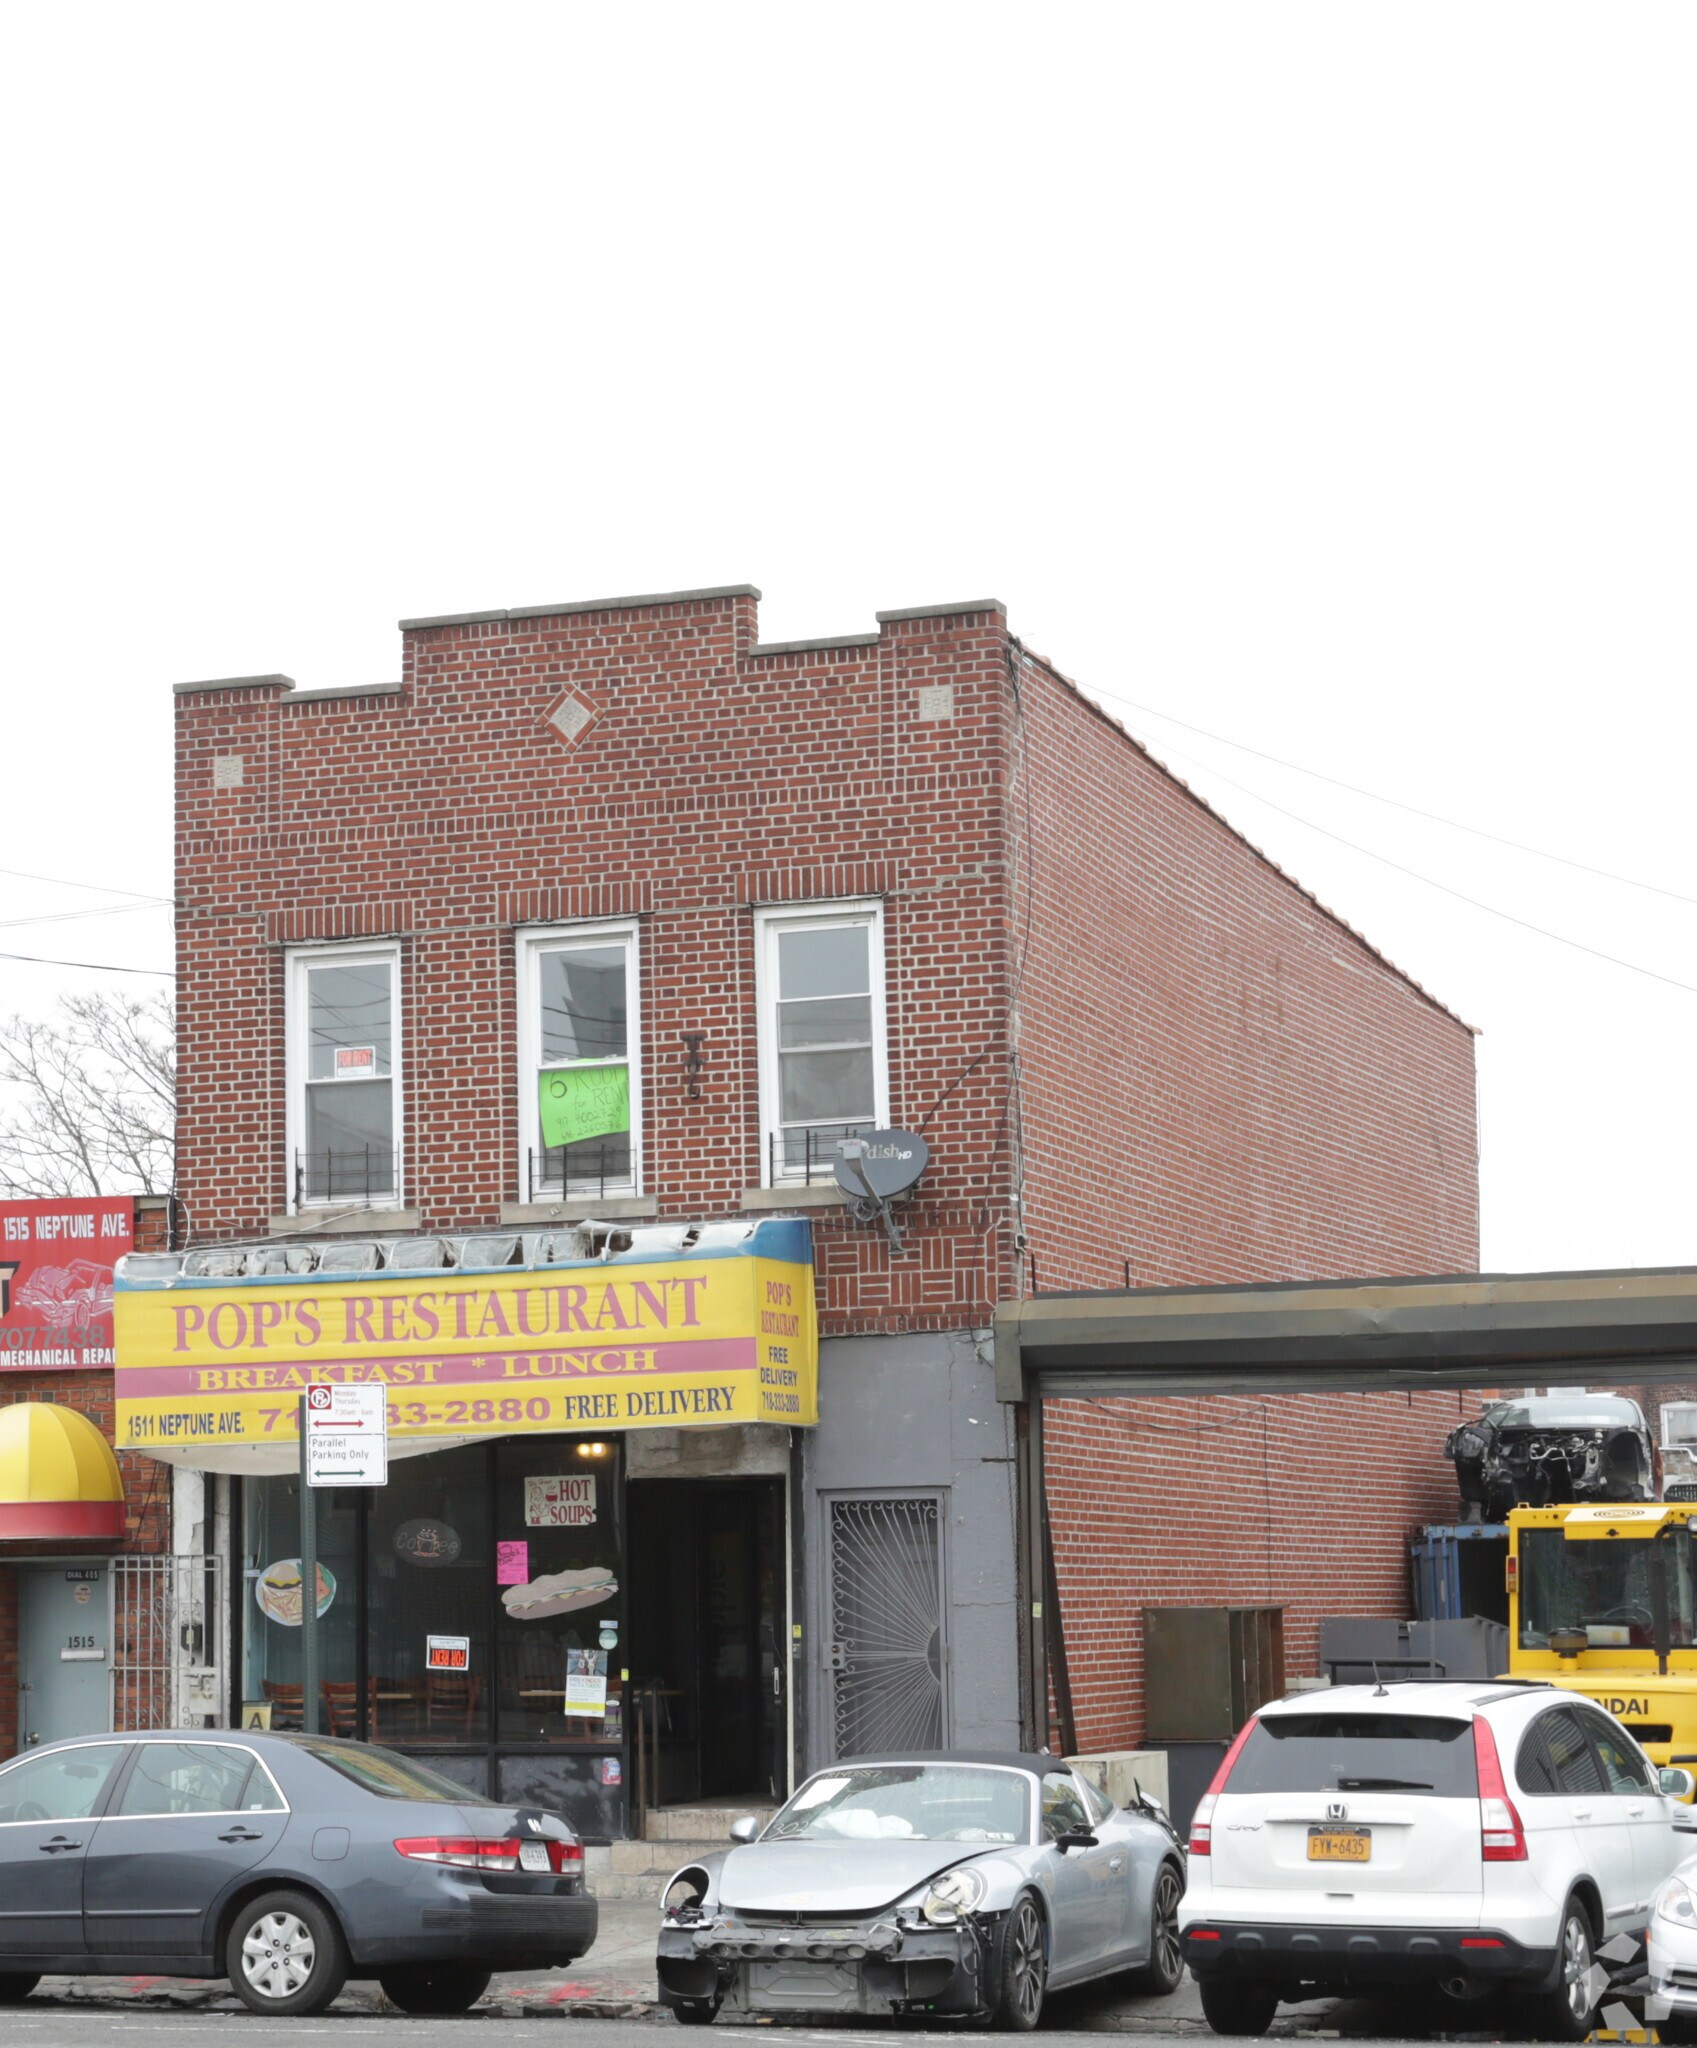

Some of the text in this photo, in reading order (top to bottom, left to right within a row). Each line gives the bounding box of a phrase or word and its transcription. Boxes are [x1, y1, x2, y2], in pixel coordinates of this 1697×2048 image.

[4, 1213, 130, 1240] 1515 NEPTUNE AVE.
[766, 1281, 792, 1306] POP'S
[172, 1274, 707, 1352] POP'S RESTAURANT
[761, 1310, 800, 1337] RESTAURANT
[1, 1348, 77, 1366] MECHANICAL
[768, 1346, 789, 1364] FREE
[195, 1349, 659, 1391] BREAKFAST LUNCH
[760, 1368, 798, 1387] DELIVERY
[334, 1390, 356, 1399] Monday
[334, 1398, 360, 1406] Thursday
[565, 1386, 736, 1420] FREE DELIVERY
[128, 1412, 245, 1438] 1511 NEPTUNE AVE.
[312, 1438, 346, 1447] Parallel
[312, 1450, 369, 1460] Parking Only
[559, 1479, 591, 1502] HOT
[550, 1504, 593, 1524] SOUPS
[396, 1532, 459, 1553] Coee
[68, 1636, 95, 1648] 1515
[249, 1712, 263, 1730] A
